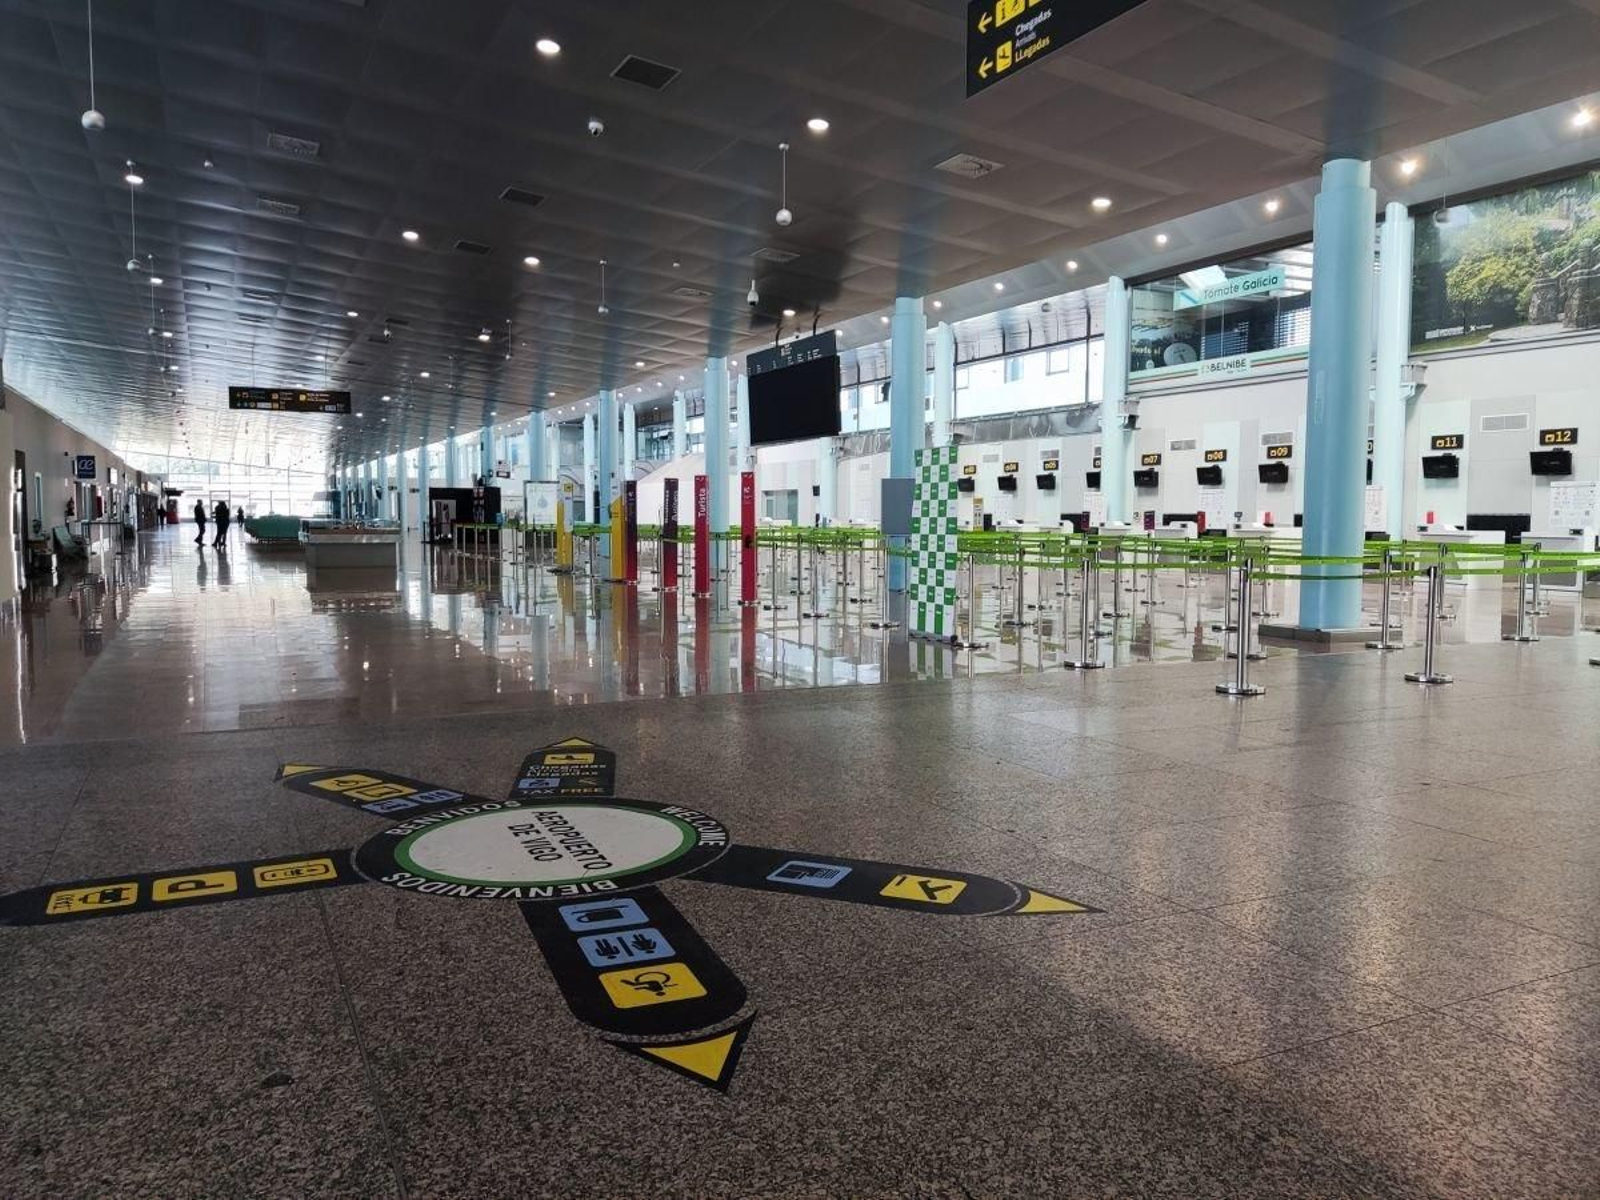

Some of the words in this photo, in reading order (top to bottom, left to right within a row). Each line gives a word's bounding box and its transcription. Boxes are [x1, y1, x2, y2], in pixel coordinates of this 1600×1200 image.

[1015, 8, 1052, 36] Chegadas
[1242, 274, 1278, 291] Galicia
[1444, 437, 1458, 448] 11
[1556, 431, 1571, 443] 12
[1276, 447, 1288, 457] 09
[698, 487, 707, 518] Turista
[384, 799, 522, 836] BENVIDOS
[508, 823, 541, 837] DE
[659, 805, 727, 848] WELCOME
[521, 837, 562, 863] VIGO
[532, 810, 613, 870] AEROPUERTO
[381, 871, 619, 899] BIENVENIDOS
